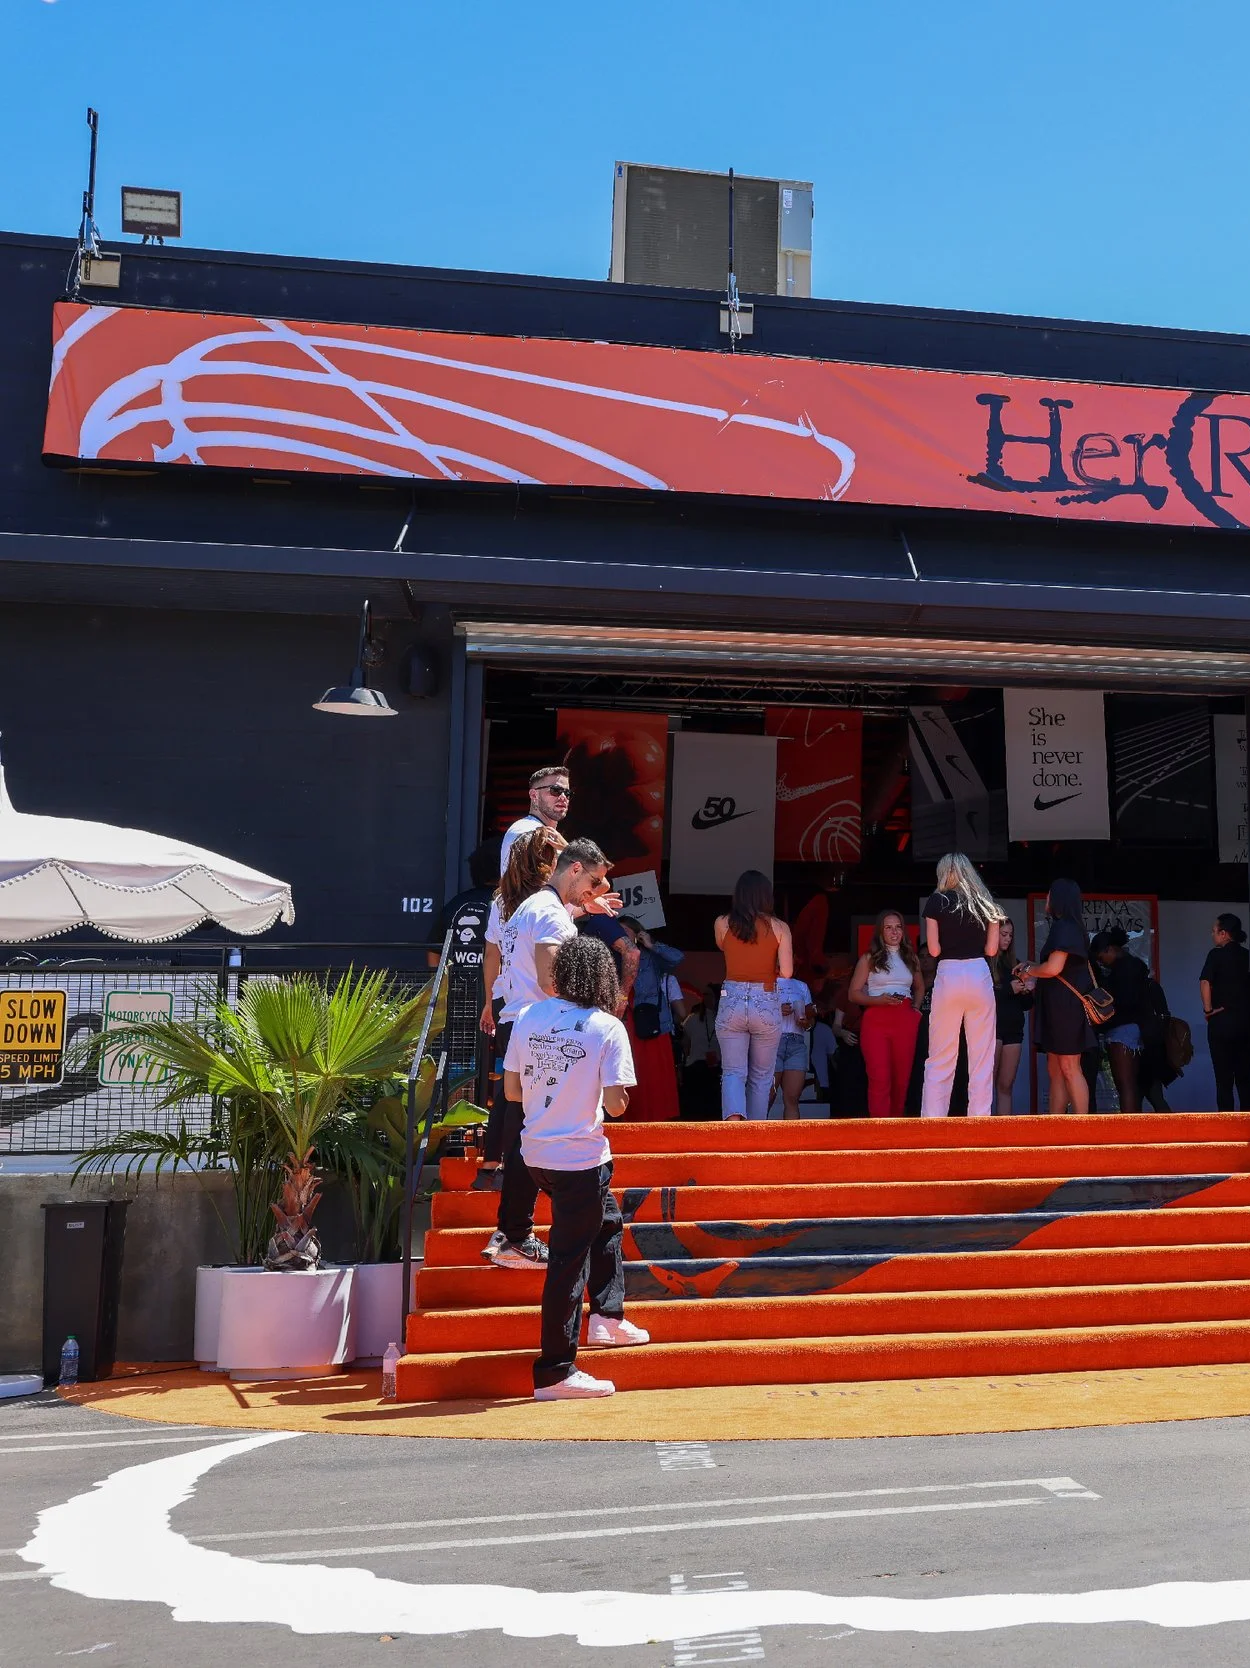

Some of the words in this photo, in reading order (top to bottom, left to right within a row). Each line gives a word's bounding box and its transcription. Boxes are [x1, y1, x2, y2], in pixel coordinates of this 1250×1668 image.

[1028, 707, 1066, 726] She
[1031, 728, 1047, 746] is
[1032, 751, 1084, 765] never
[1032, 767, 1083, 787] done.
[703, 796, 736, 818] 50
[401, 897, 433, 913] 102
[1081, 900, 1131, 916] RENA
[7, 999, 57, 1020] SLOW
[109, 1011, 169, 1023] MOTORCYCLE
[3, 1023, 57, 1044] DOWN
[0, 1053, 30, 1063] SPEED
[33, 1053, 60, 1063] LIMIT
[118, 1054, 151, 1068] ONLY
[19, 1064, 56, 1078] MPH
